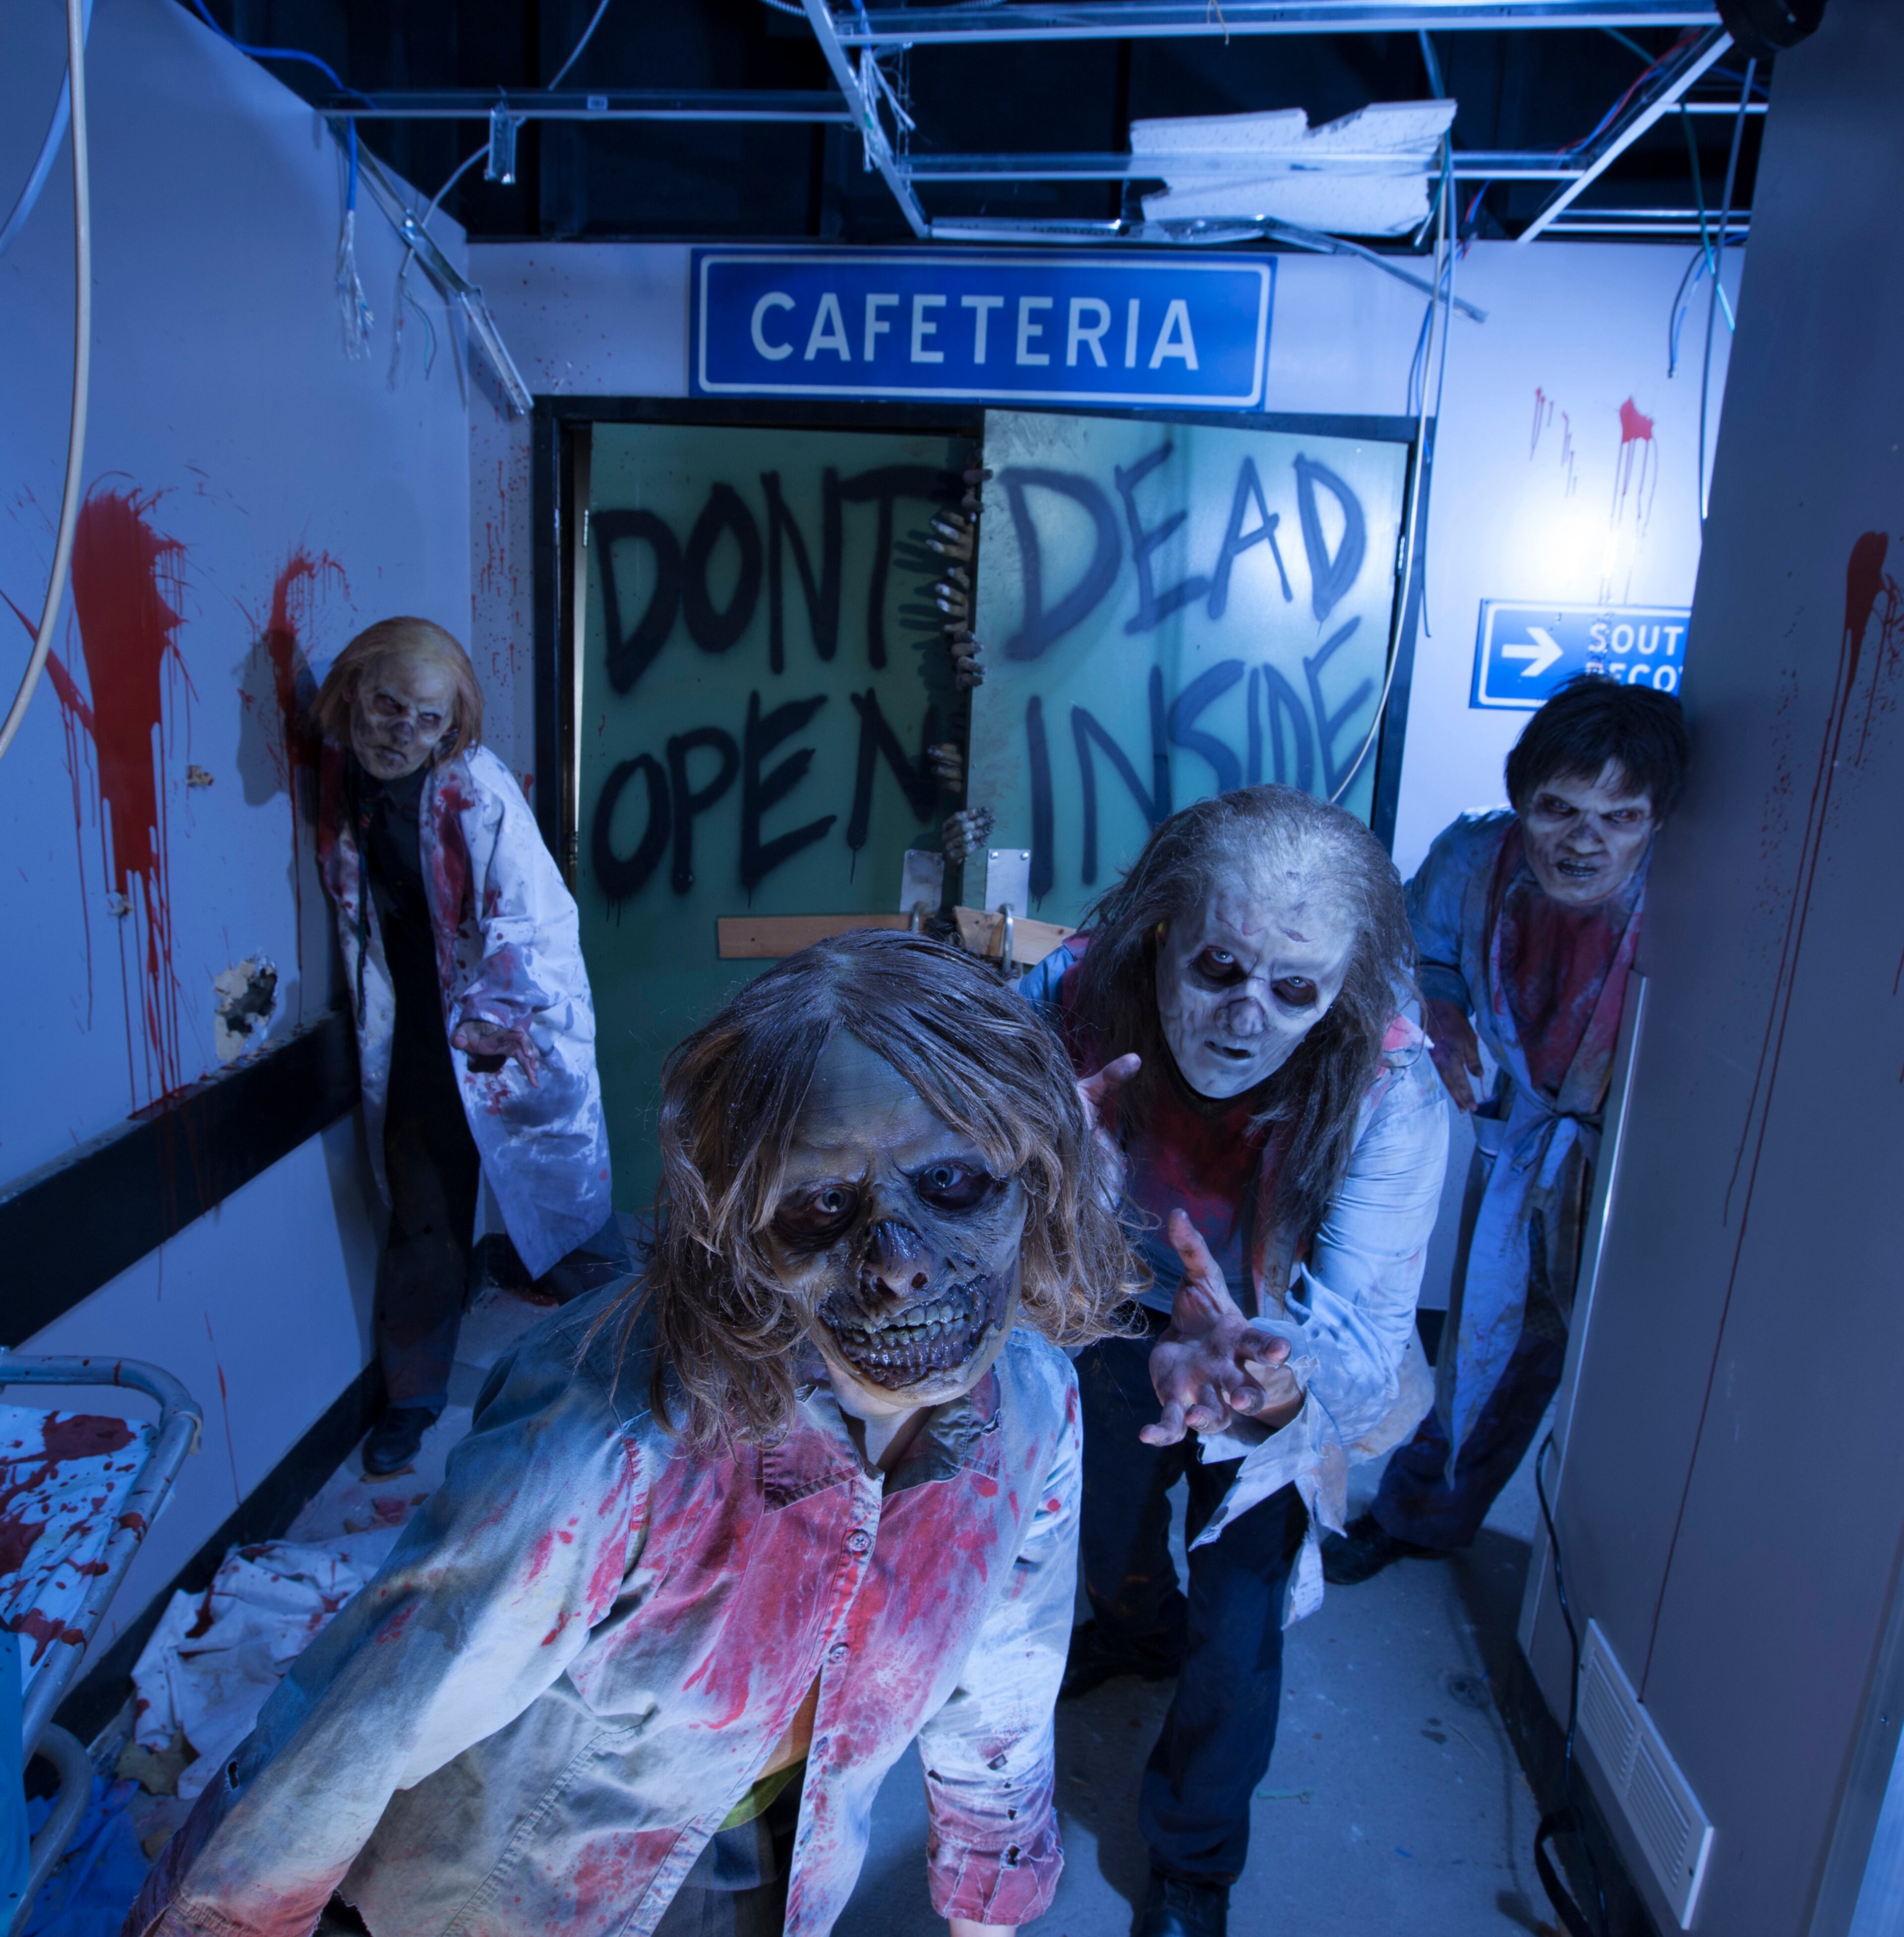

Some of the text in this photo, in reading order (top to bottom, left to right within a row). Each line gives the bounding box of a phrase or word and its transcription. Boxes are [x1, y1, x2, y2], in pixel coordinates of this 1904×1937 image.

[751, 291, 1199, 371] CAFETERIA
[591, 465, 967, 695] DONT
[998, 440, 1367, 662] DEAD
[592, 687, 939, 899] OPEN
[1025, 615, 1375, 901] INSIDE
